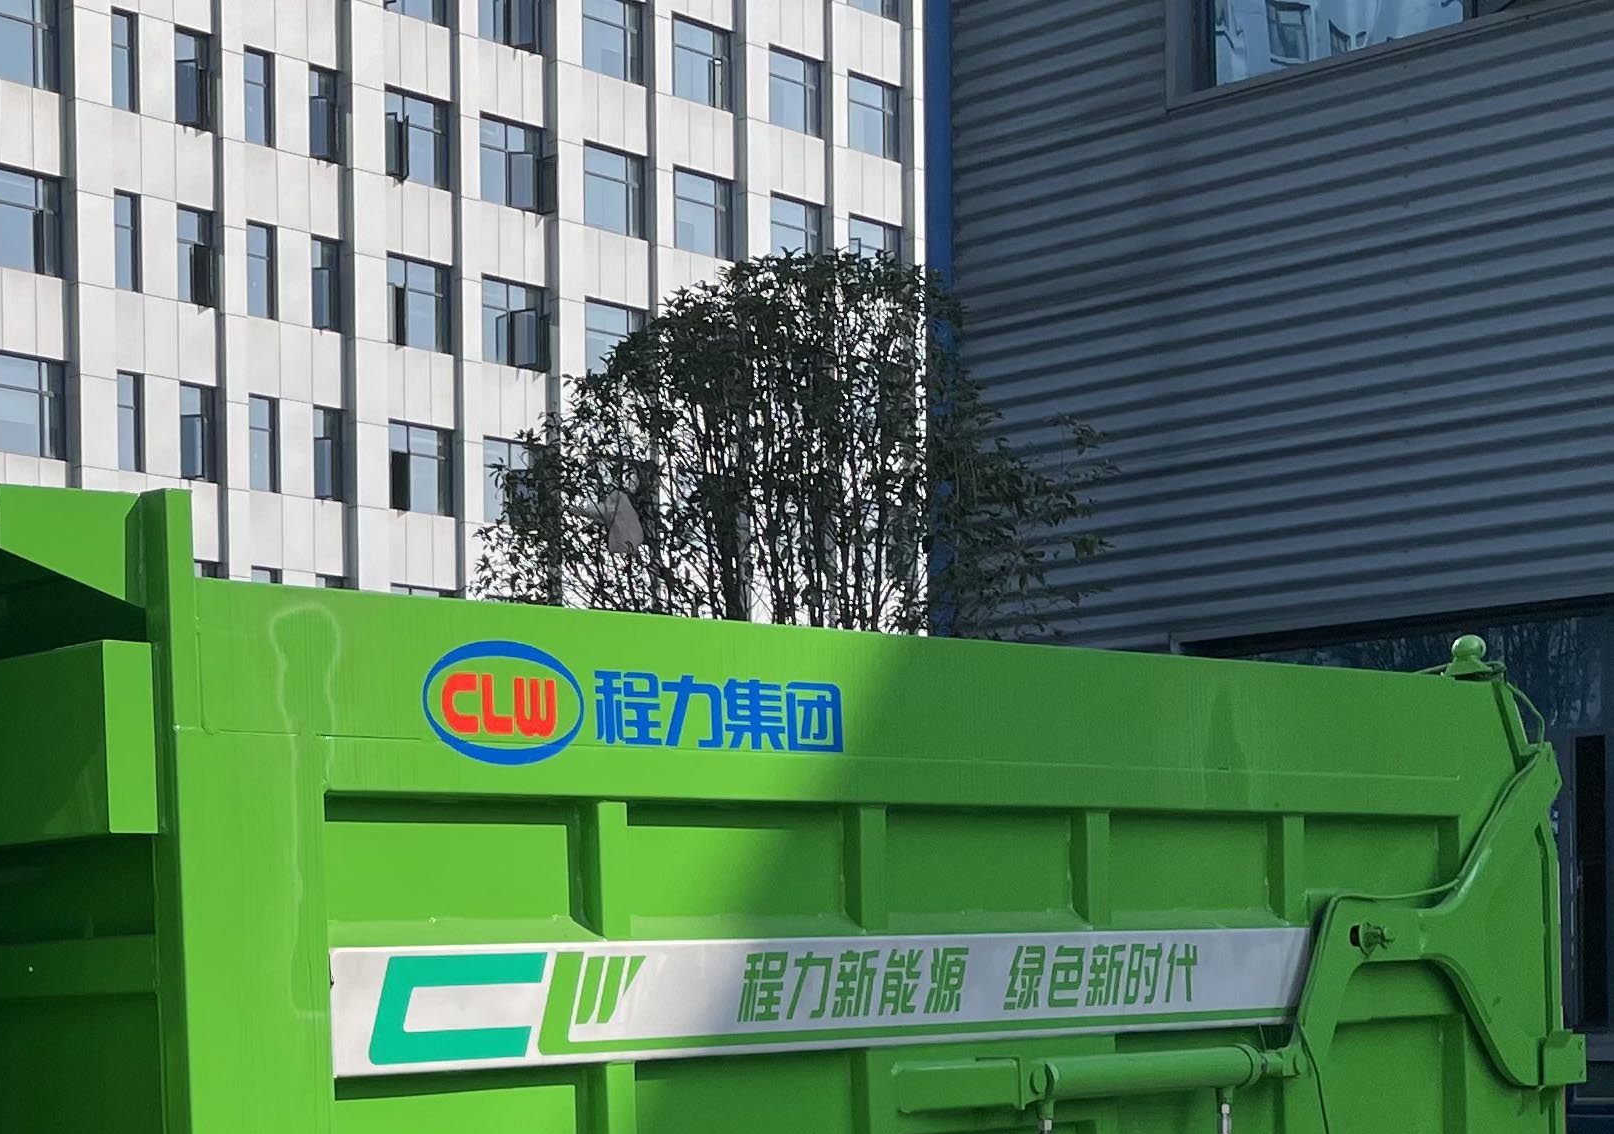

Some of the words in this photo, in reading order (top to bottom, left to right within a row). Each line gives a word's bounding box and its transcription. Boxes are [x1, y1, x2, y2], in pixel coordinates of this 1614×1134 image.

[442, 672, 556, 738] CLW
[594, 670, 844, 753] 程力集团
[736, 946, 970, 1023] 程力新能源
[1002, 942, 1198, 1011] 绿色新时代
